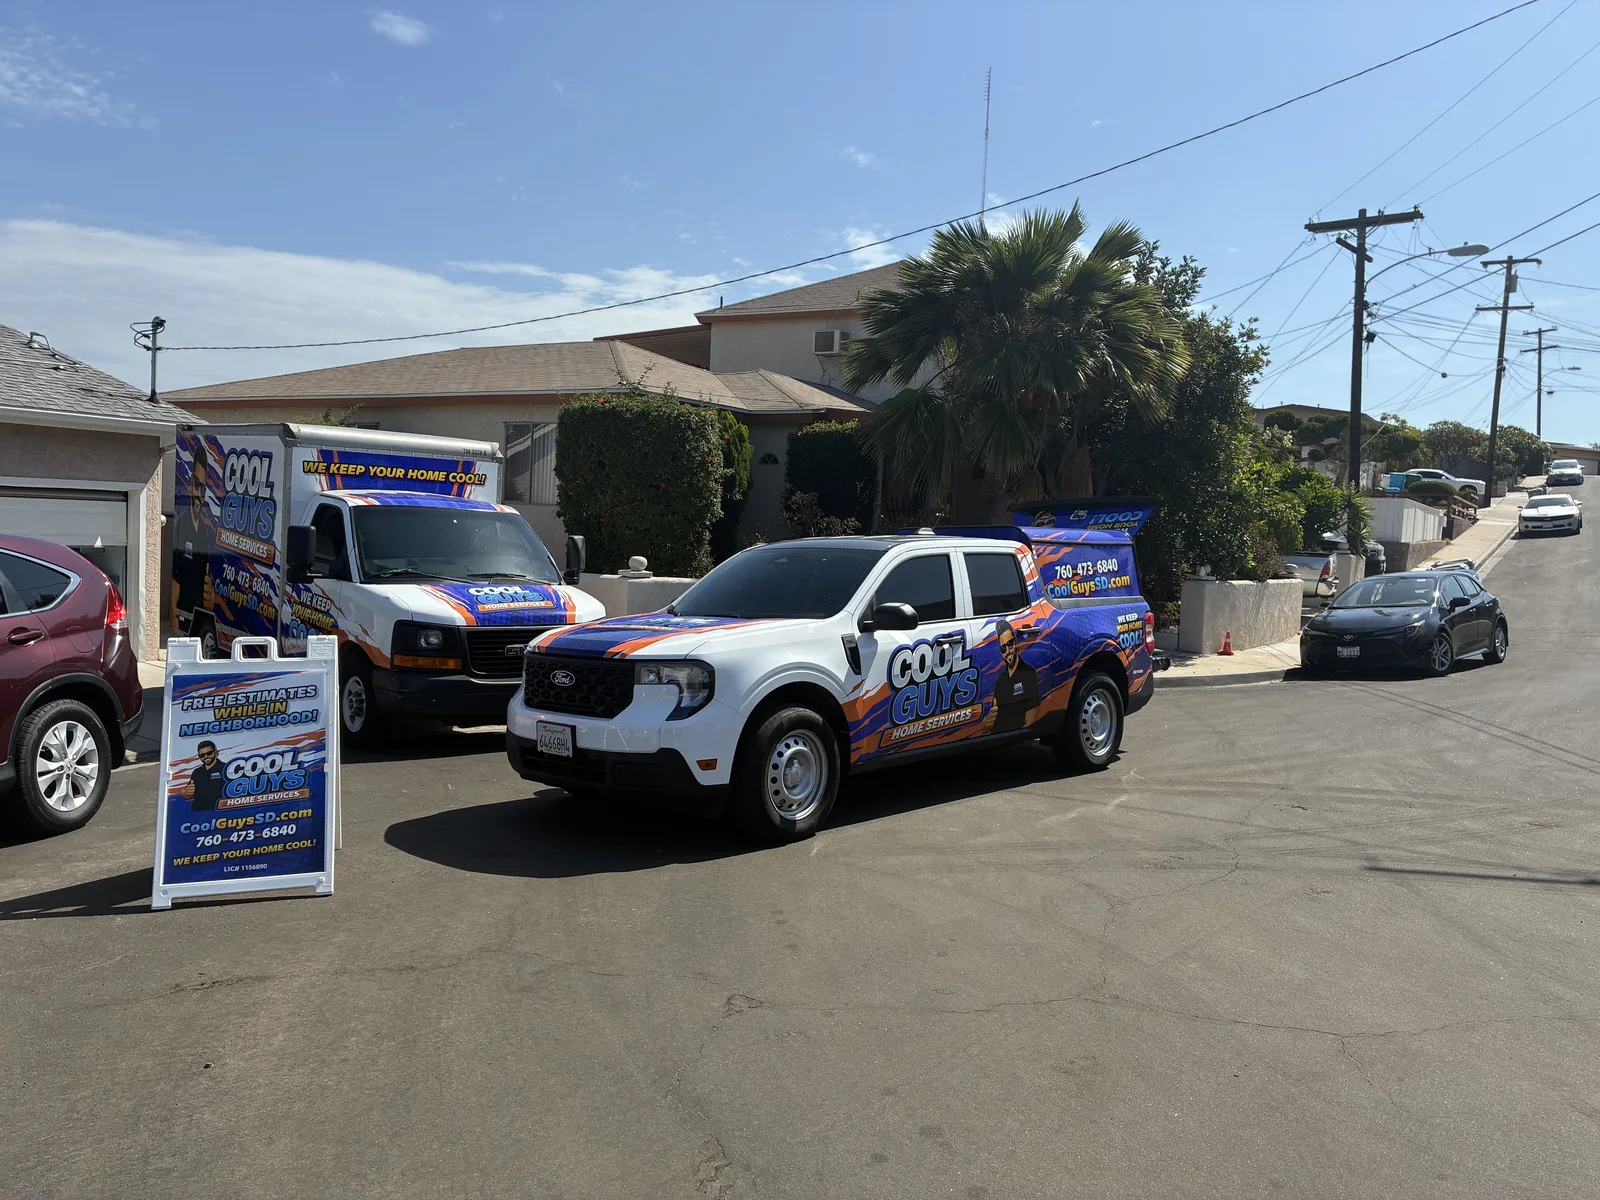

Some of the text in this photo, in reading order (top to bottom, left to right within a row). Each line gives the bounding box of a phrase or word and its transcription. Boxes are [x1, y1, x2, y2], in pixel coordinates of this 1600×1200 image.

[224, 453, 274, 498] COOL
[303, 461, 487, 486] WE KEEP YOUR HOME COOL!
[222, 494, 275, 539] GUYS
[1089, 510, 1143, 525] COOL!
[220, 530, 268, 559] HOME SERVICES
[1055, 558, 1118, 579] 760-473-6840
[468, 586, 530, 595] COOL
[477, 592, 544, 604] GUYS
[1047, 574, 1131, 598] CoolGuysSD.com
[214, 578, 276, 620] CoolGuysSD.com
[300, 590, 331, 612] WE KEEP
[292, 602, 335, 631] YOUR HOME
[1116, 621, 1143, 633] YOUR HOME
[1117, 615, 1126, 623] WE
[1120, 630, 1143, 649] COOL!
[891, 636, 970, 689] COOL
[553, 672, 573, 685] Ford
[182, 685, 318, 711] FREE ESTIMATES
[892, 669, 978, 725] GUYS
[214, 701, 287, 720] WHILE IN
[180, 710, 319, 737] NEIGHBORHOOD!
[891, 708, 972, 740] HOME SERVICES
[226, 751, 299, 780] COOL
[226, 769, 306, 798] GUYS
[227, 790, 300, 806] HOME SERVICES
[180, 808, 312, 834] CoolGuysSD.com
[196, 824, 297, 848] 760-473-6840
[173, 839, 317, 866] WE KEEP YOUR HOME COOL!
